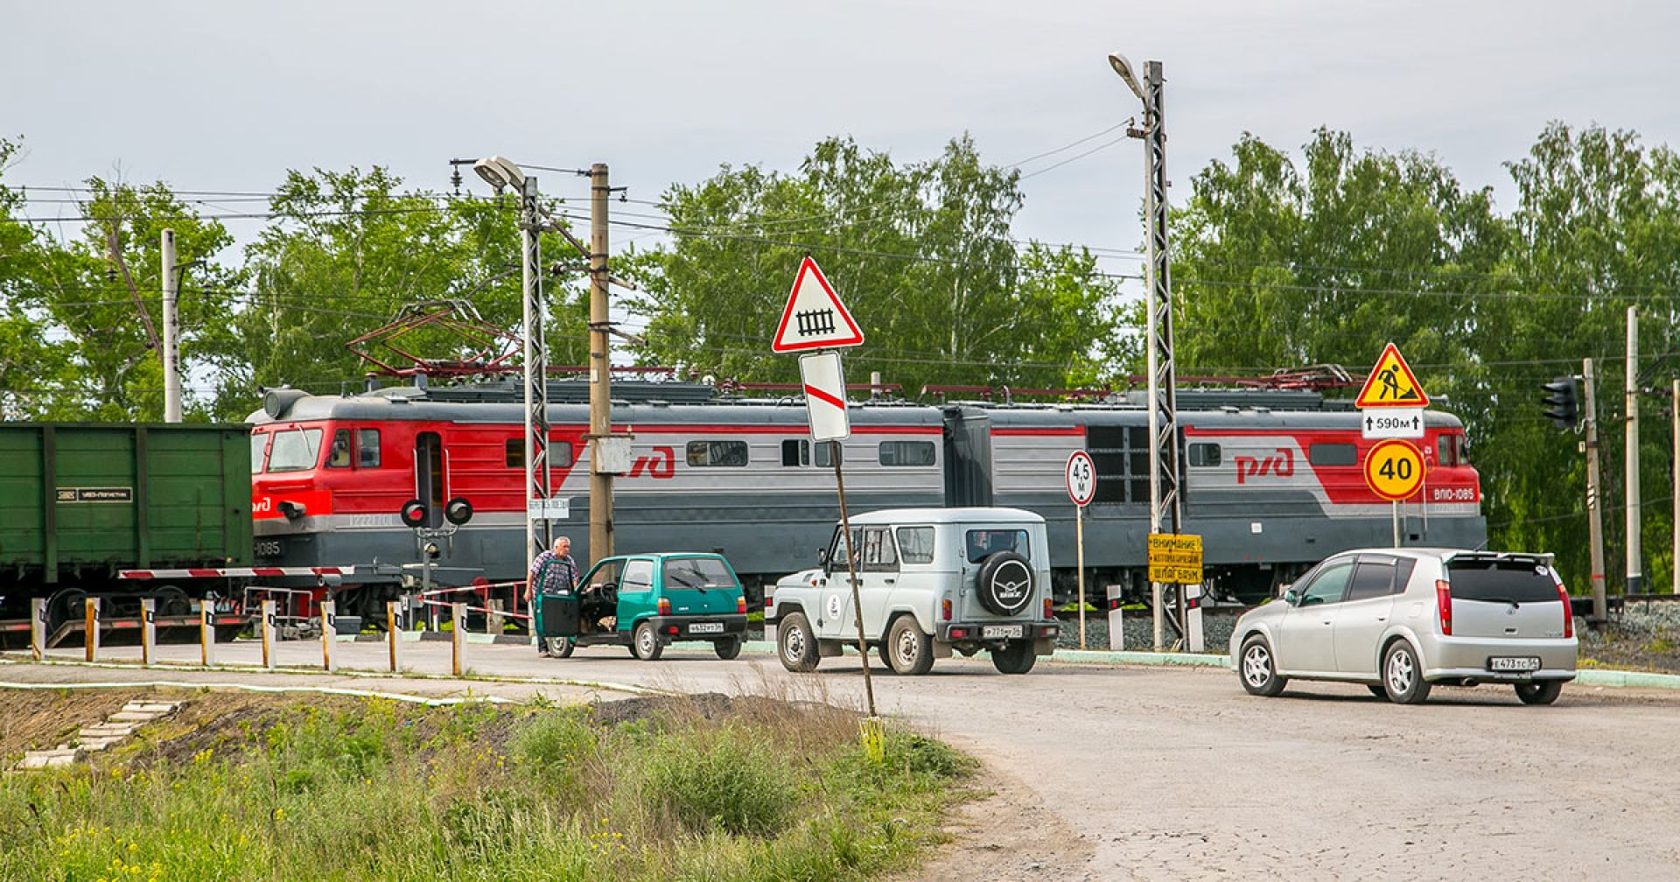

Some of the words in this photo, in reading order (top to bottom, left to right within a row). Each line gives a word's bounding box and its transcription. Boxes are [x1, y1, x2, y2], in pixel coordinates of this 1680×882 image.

[1377, 418, 1410, 429] 590м
[1073, 463, 1089, 482] 4,5
[1379, 457, 1412, 480] 40
